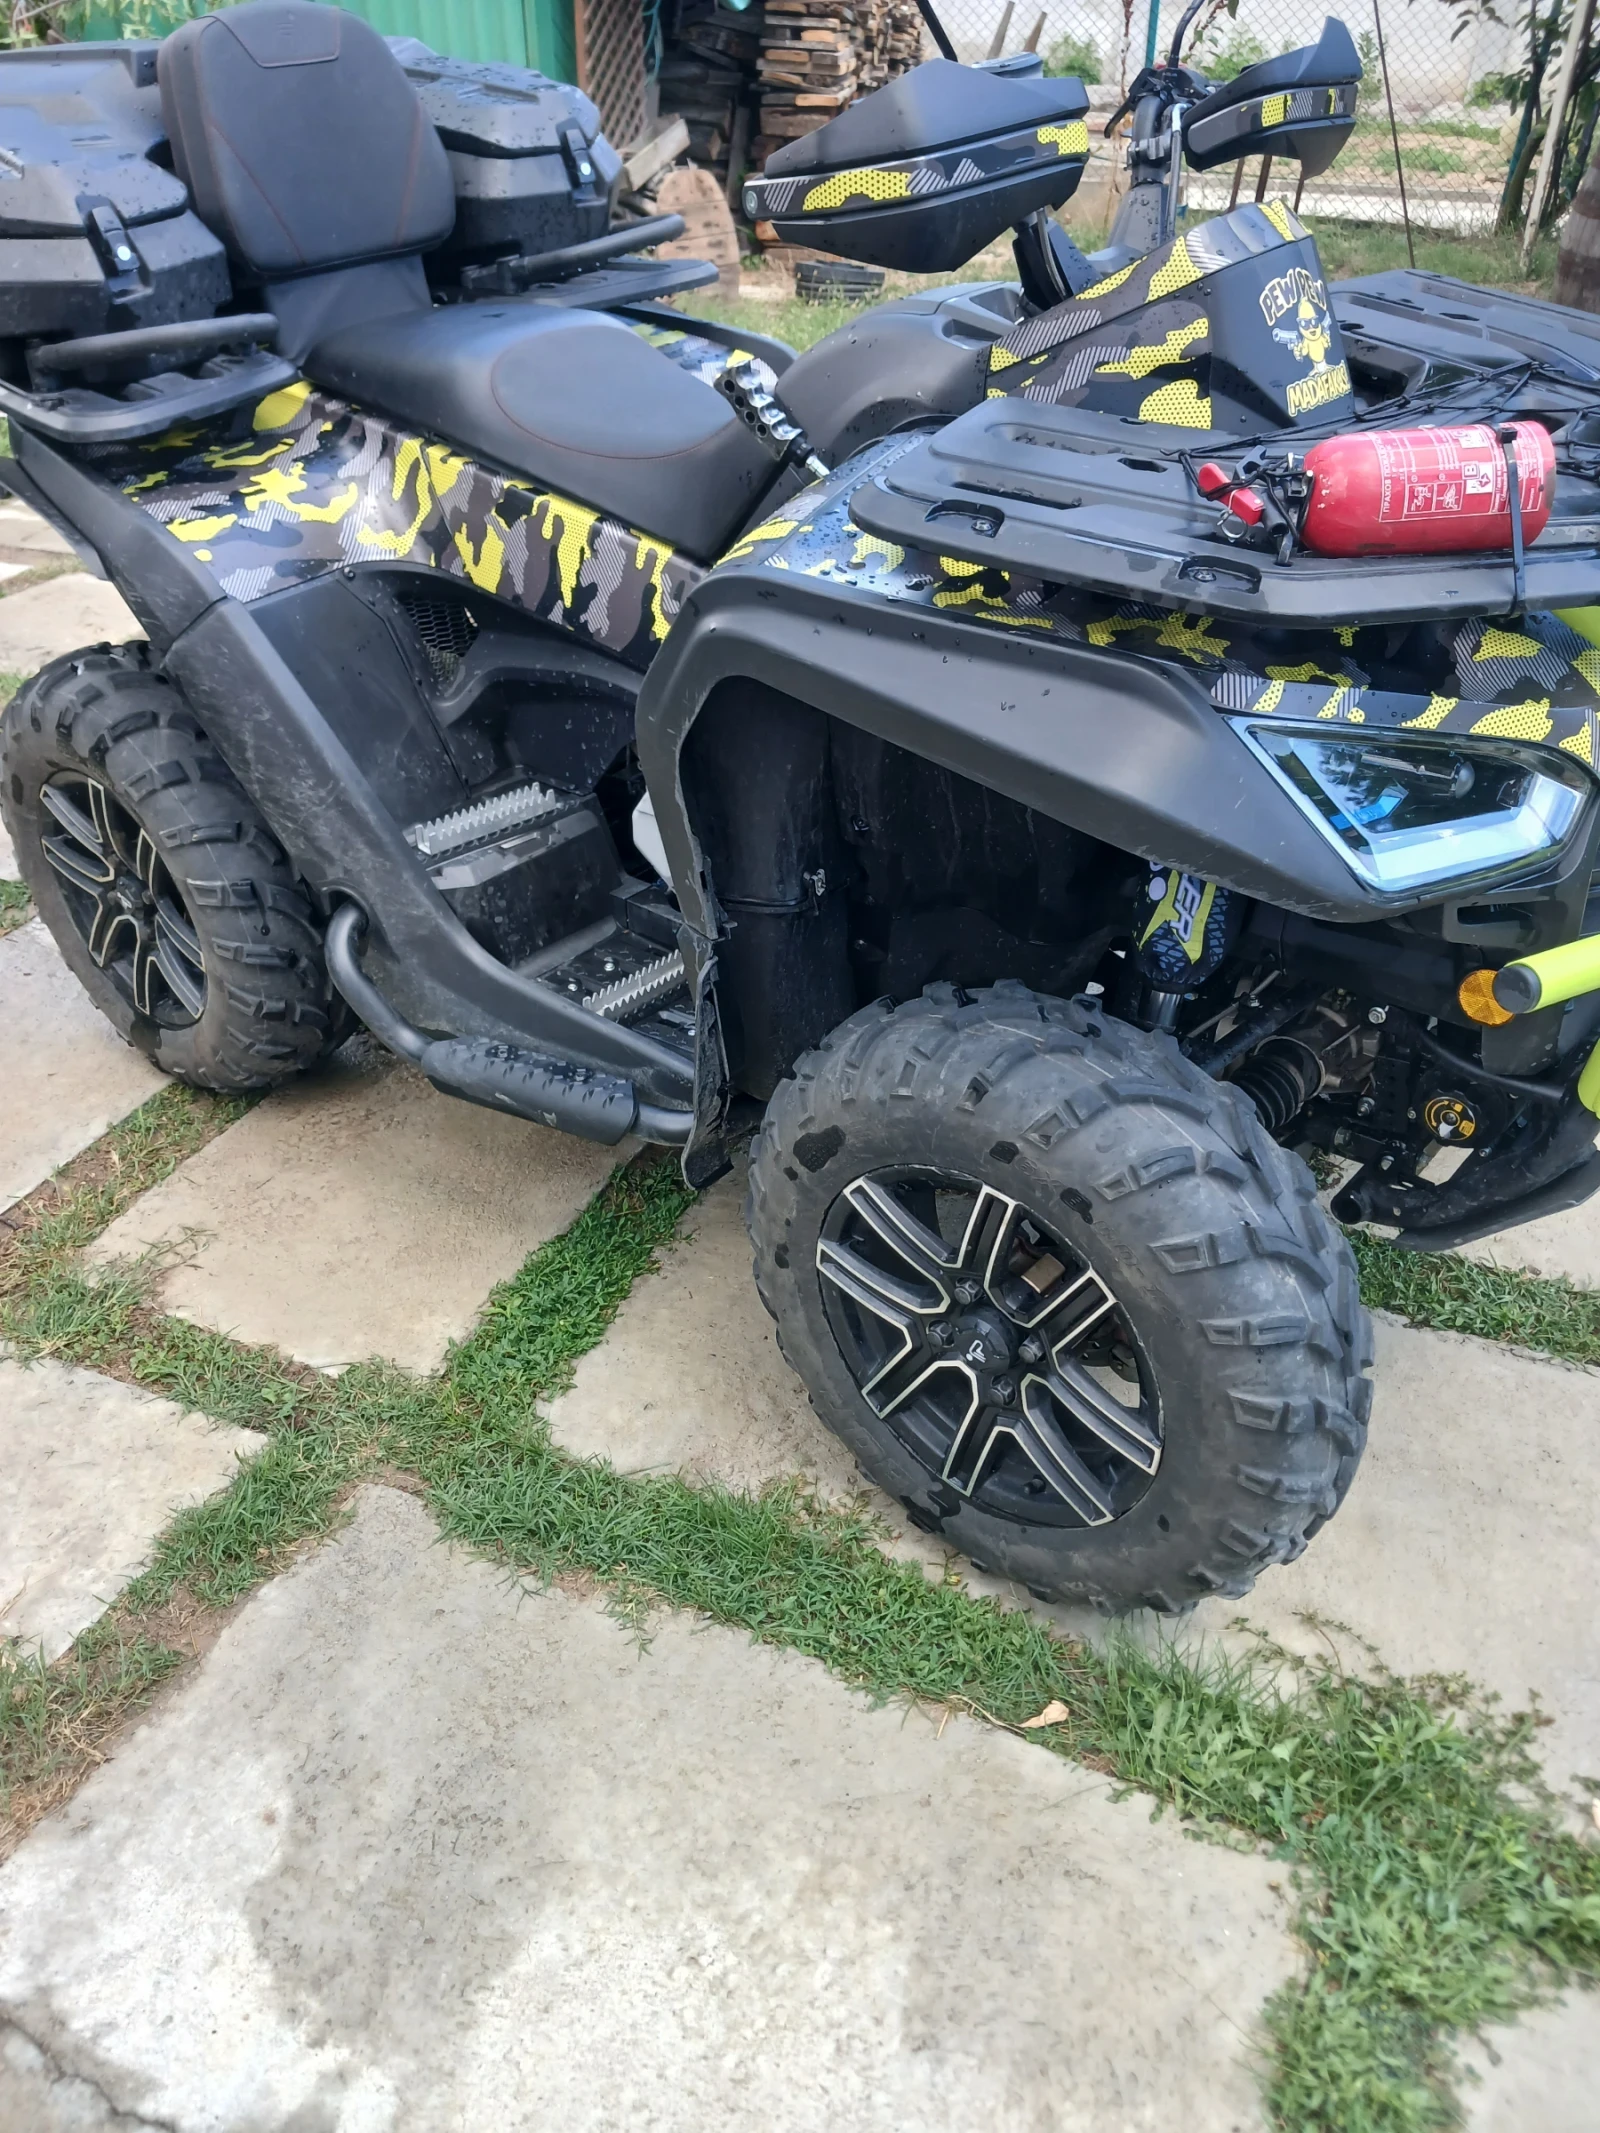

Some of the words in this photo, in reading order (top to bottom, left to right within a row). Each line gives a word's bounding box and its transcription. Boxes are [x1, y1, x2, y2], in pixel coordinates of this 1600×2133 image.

[1260, 268, 1298, 326] PEW
[1295, 267, 1327, 311] PEW
[1383, 479, 1392, 513] ПРАХОВ
[1169, 873, 1202, 942] ER
